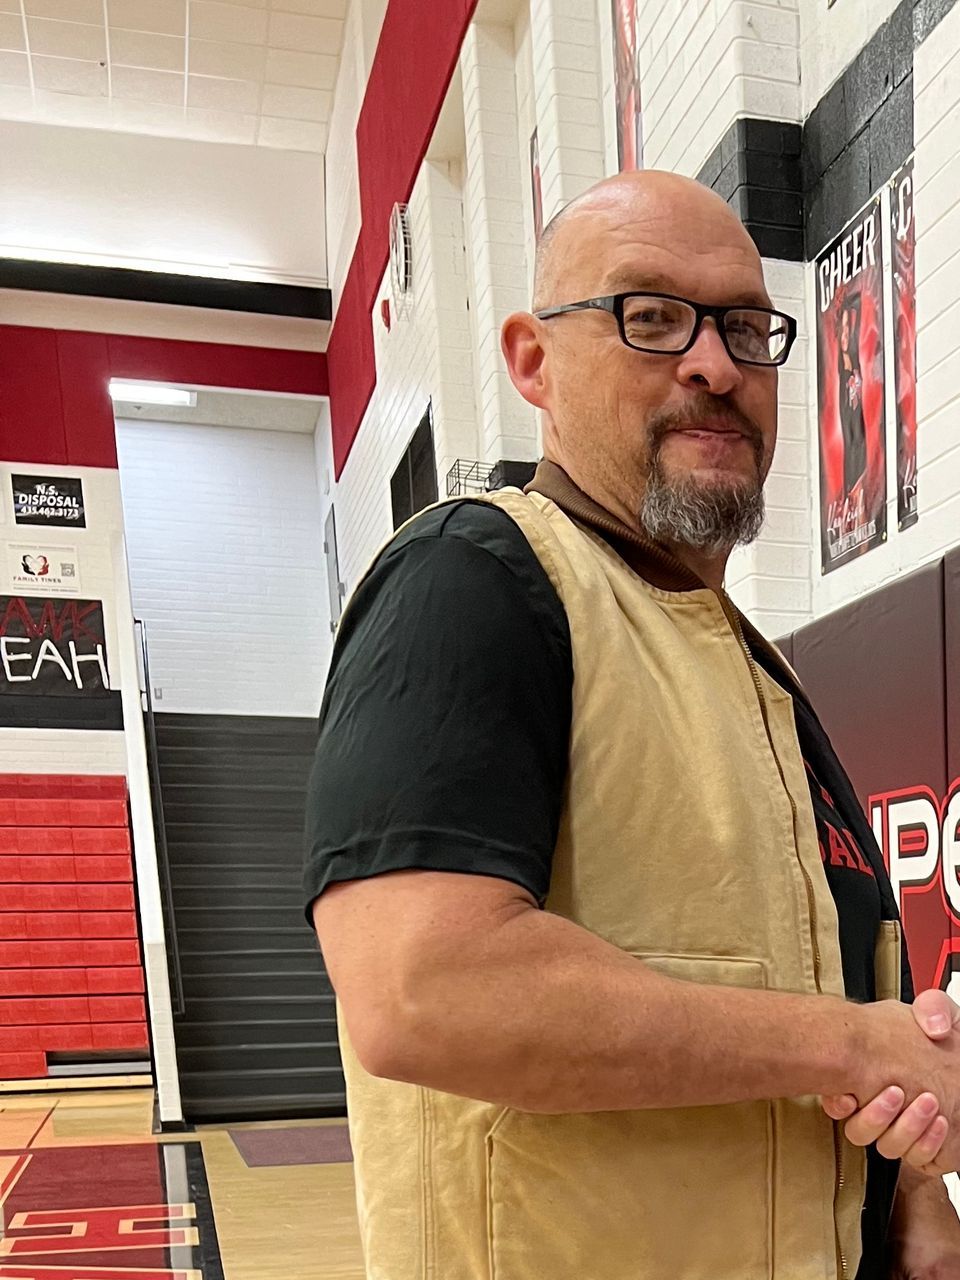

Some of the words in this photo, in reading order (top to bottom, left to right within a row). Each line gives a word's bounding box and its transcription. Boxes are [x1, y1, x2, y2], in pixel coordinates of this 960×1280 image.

[819, 213, 876, 313] CHEER
[36, 484, 58, 496] N.S.
[18, 493, 80, 508] DISPOSAL
